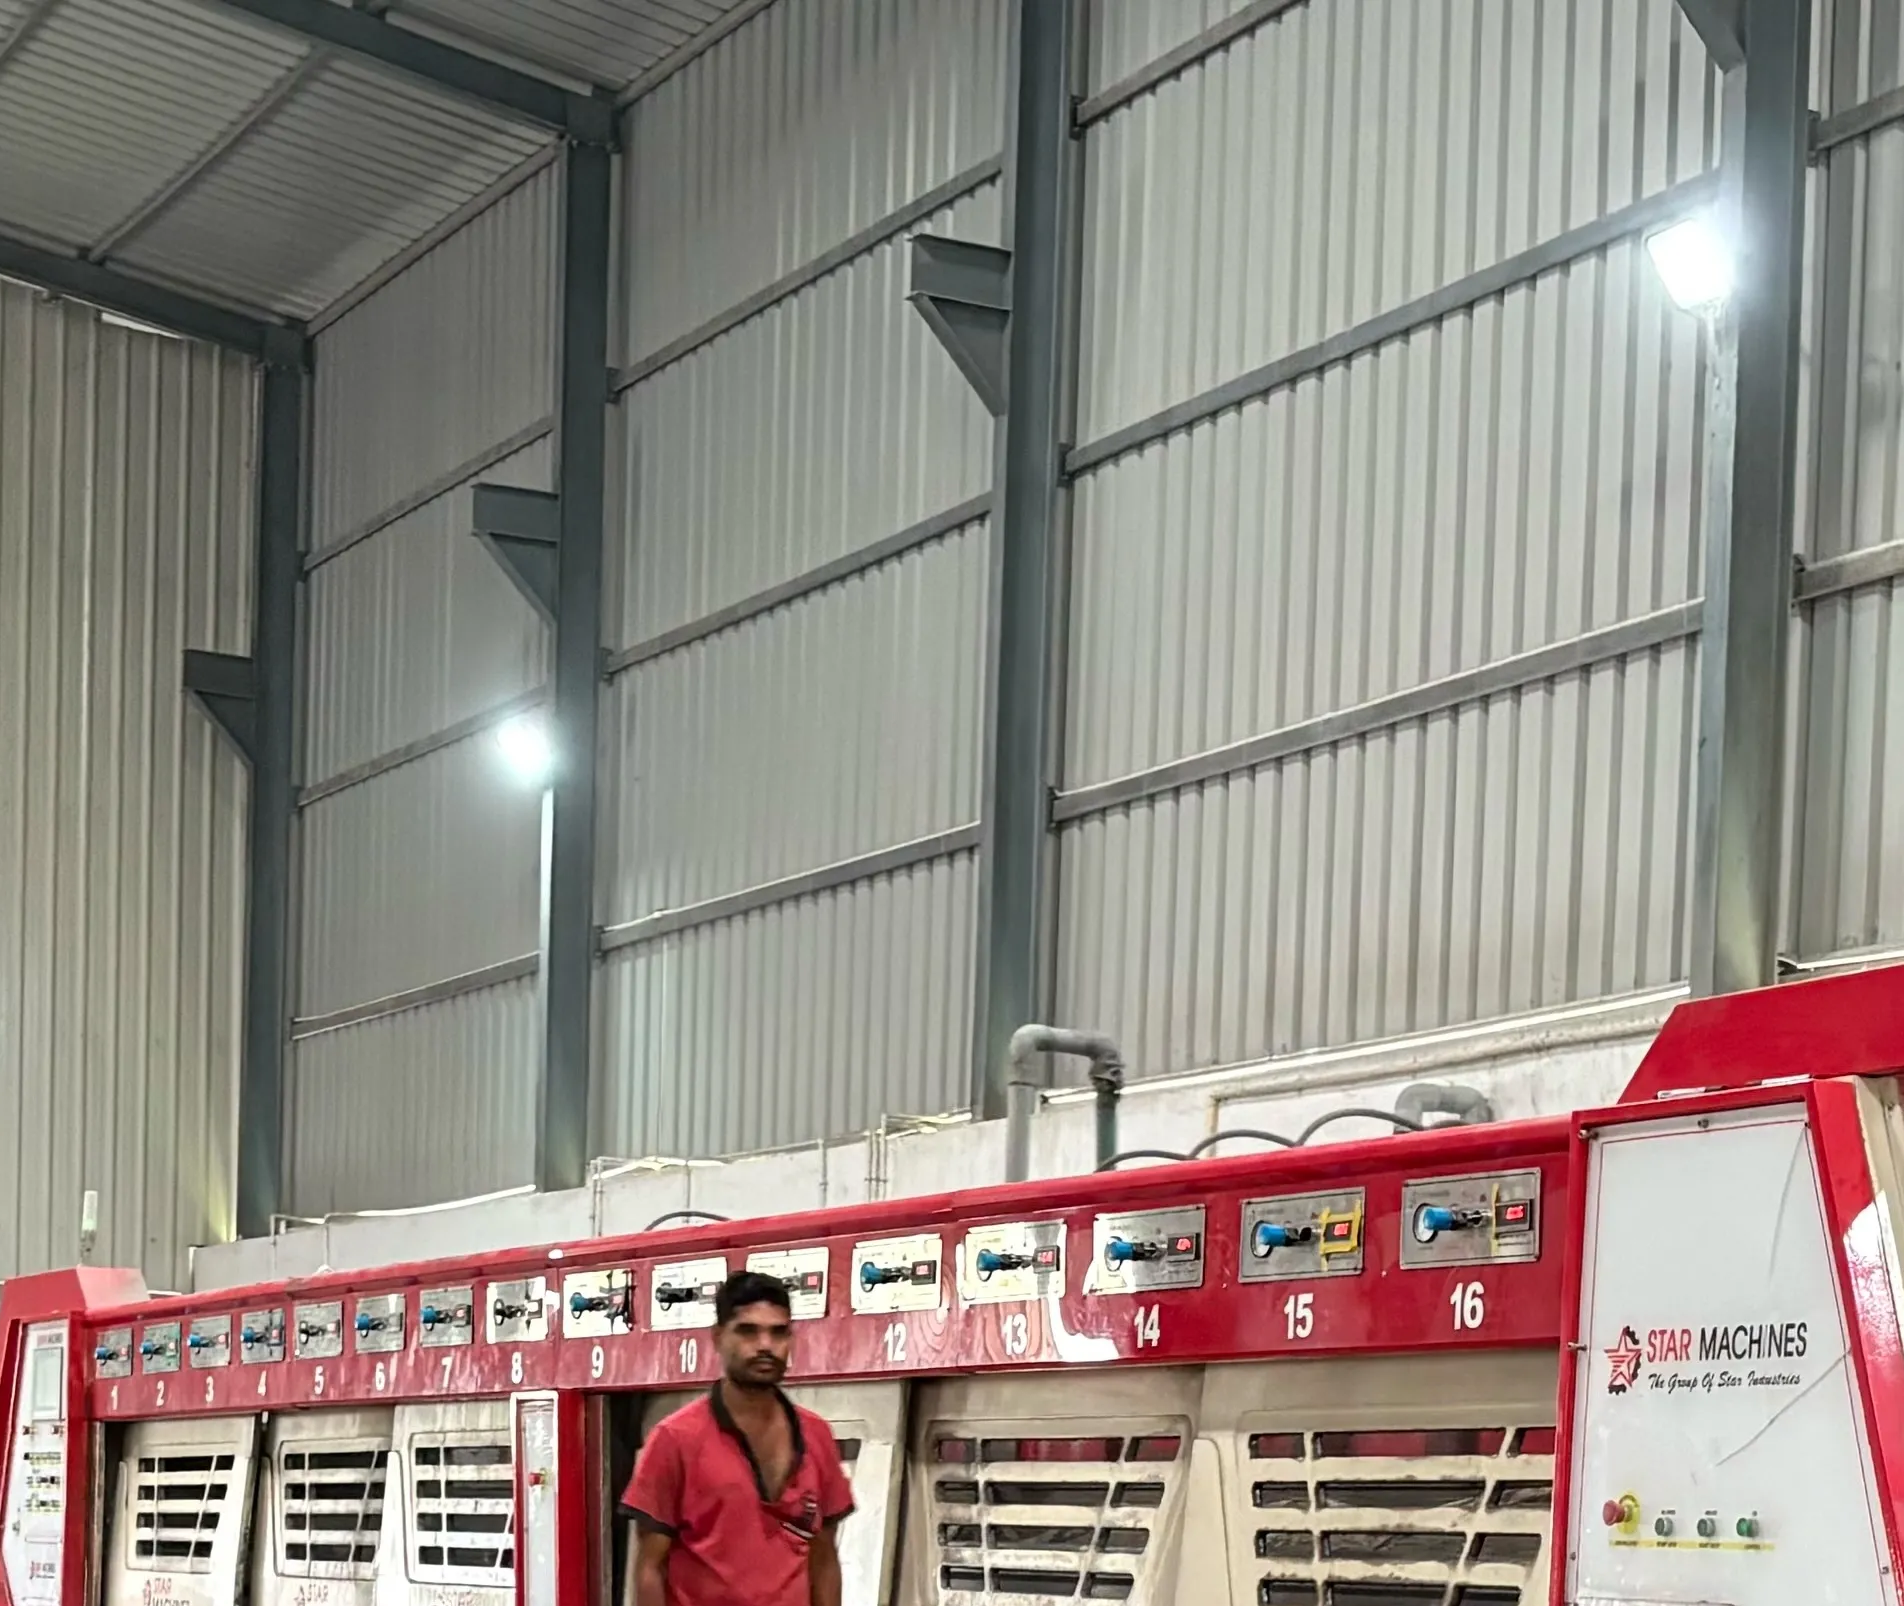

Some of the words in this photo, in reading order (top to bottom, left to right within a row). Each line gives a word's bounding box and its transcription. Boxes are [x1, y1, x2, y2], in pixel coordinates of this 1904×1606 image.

[1283, 1292, 1314, 1340] 15
[1450, 1281, 1485, 1330] 16
[883, 1322, 907, 1362] 12
[1001, 1313, 1028, 1356] 13
[1133, 1304, 1160, 1348] 14
[1647, 1328, 1692, 1363] STAR
[1698, 1322, 1808, 1361] MACHINES
[441, 1355, 453, 1388] 7
[511, 1351, 523, 1384] 8
[591, 1345, 604, 1378] 9
[678, 1338, 697, 1374] 10
[205, 1375, 215, 1404] 3
[257, 1370, 267, 1397] 4
[314, 1364, 324, 1395] 5
[375, 1361, 386, 1391] 6
[1648, 1373, 1665, 1390] The
[1667, 1373, 1697, 1394] Group
[1701, 1373, 1715, 1394] Of
[1717, 1371, 1743, 1387] Star
[110, 1384, 118, 1411] 1
[156, 1380, 166, 1407] 2
